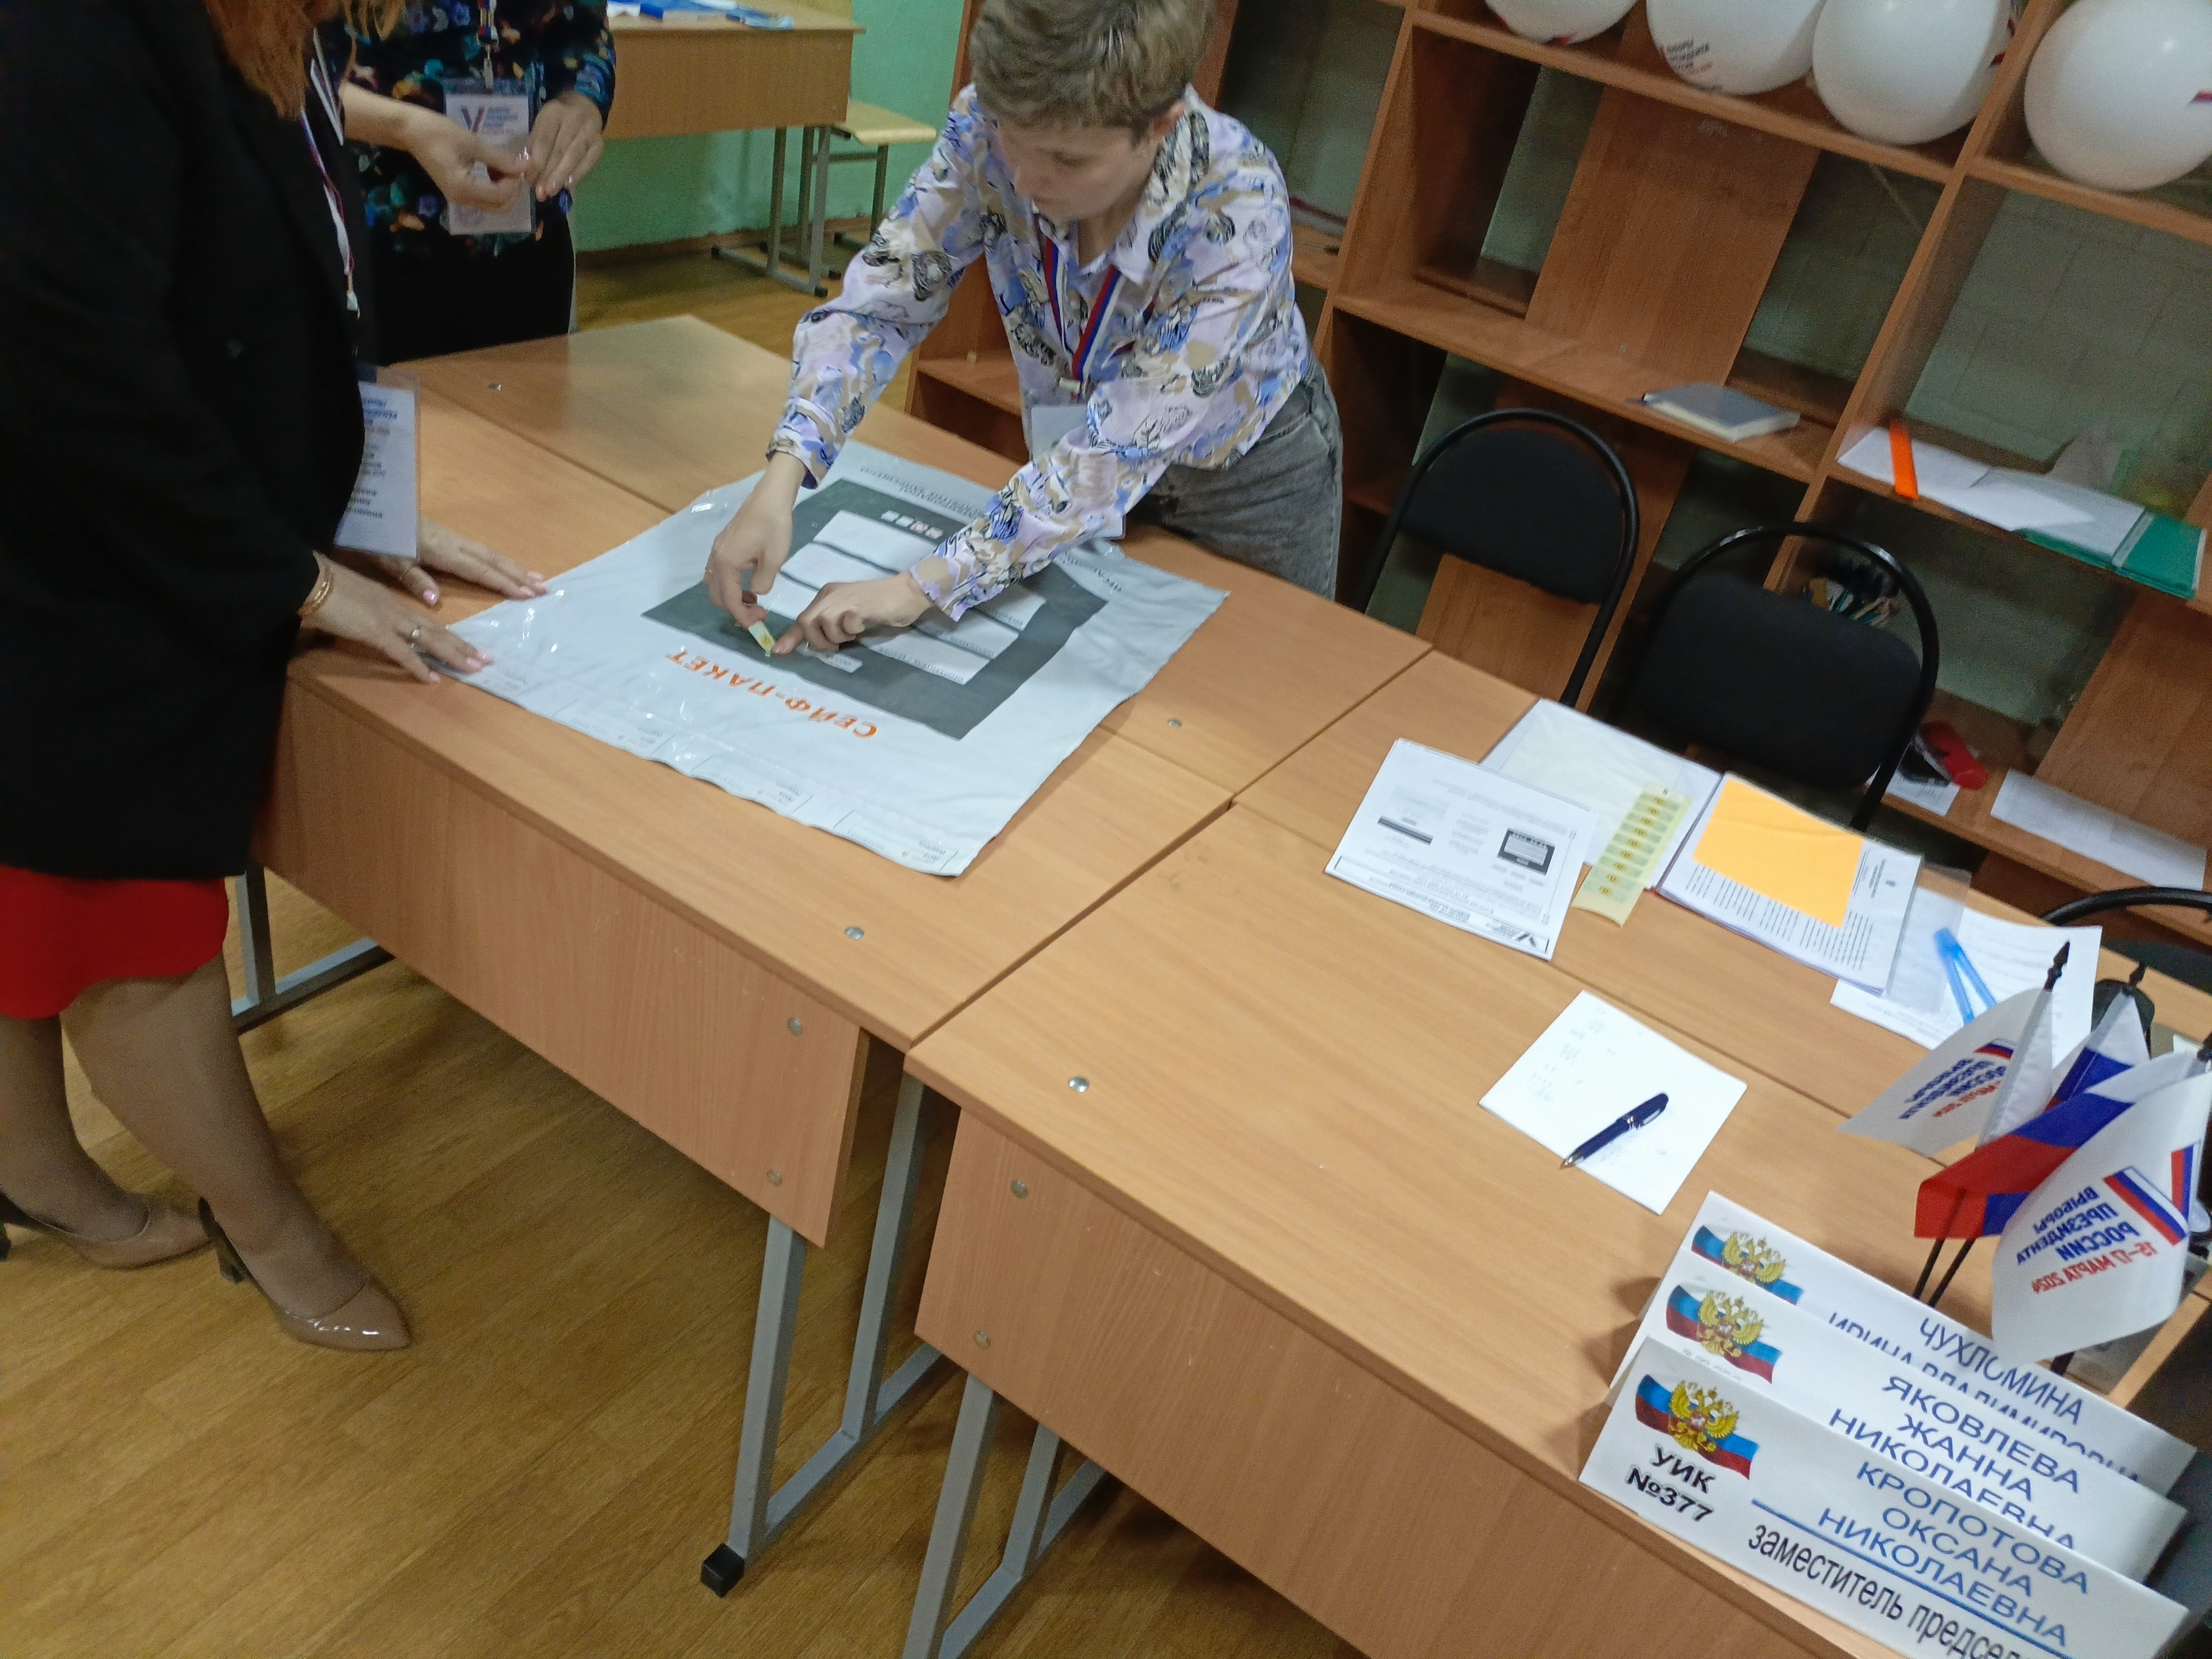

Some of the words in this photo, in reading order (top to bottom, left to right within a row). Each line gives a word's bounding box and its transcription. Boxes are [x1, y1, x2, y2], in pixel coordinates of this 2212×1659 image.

[665, 649, 878, 740] СЕЙФ-ПАКЕТ
[1920, 1317, 2083, 1426] ЧУХЛОМИНА
[1651, 1443, 1716, 1495] УИК
[1881, 1375, 2080, 1494] ЯКОВЛЕВА
[1897, 1413, 2033, 1503] ЖАННА
[1625, 1464, 1714, 1522] №377
[1856, 1461, 2088, 1595] КРОПОТОВА
[1748, 1524, 1904, 1621] заместитель
[1907, 1602, 2022, 1659] предсе
[1818, 1508, 2067, 1648] НИКОЛАЕВНА
[1882, 1508, 2034, 1598] ОКСАНА
